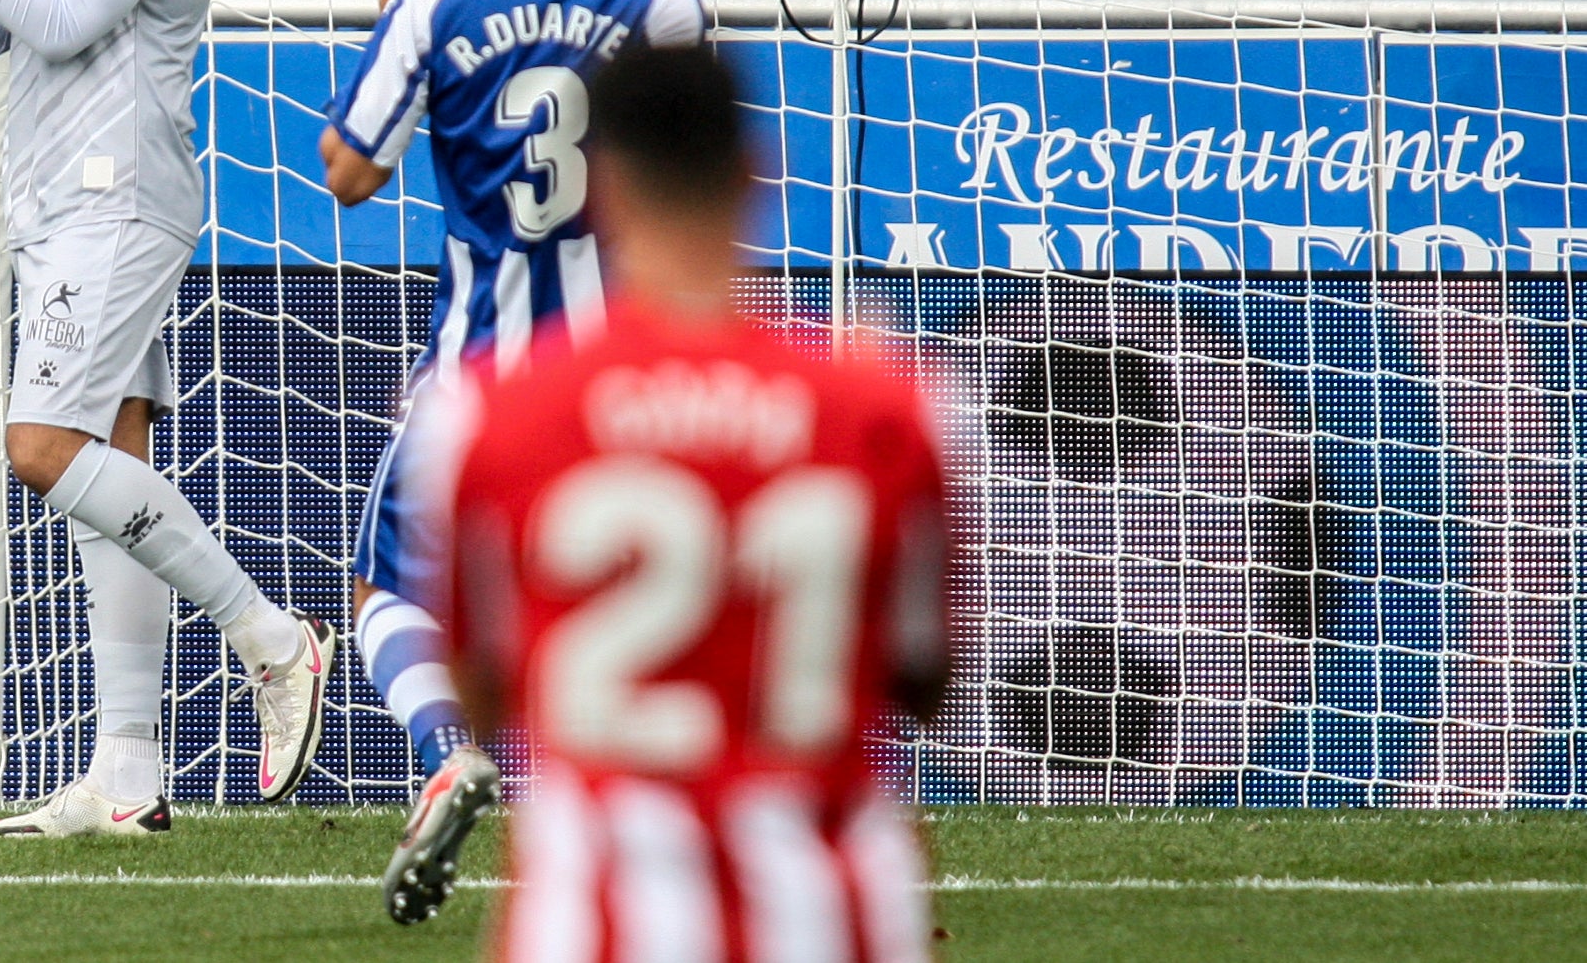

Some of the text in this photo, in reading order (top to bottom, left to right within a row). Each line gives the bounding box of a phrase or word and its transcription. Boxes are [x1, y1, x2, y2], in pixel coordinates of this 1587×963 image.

[446, 3, 630, 76] R.DUARTE
[495, 66, 590, 243] 3
[955, 101, 1526, 206] Restaurante
[26, 319, 85, 346] INTEGRA
[29, 378, 61, 388] KELME
[529, 460, 872, 770] 21
